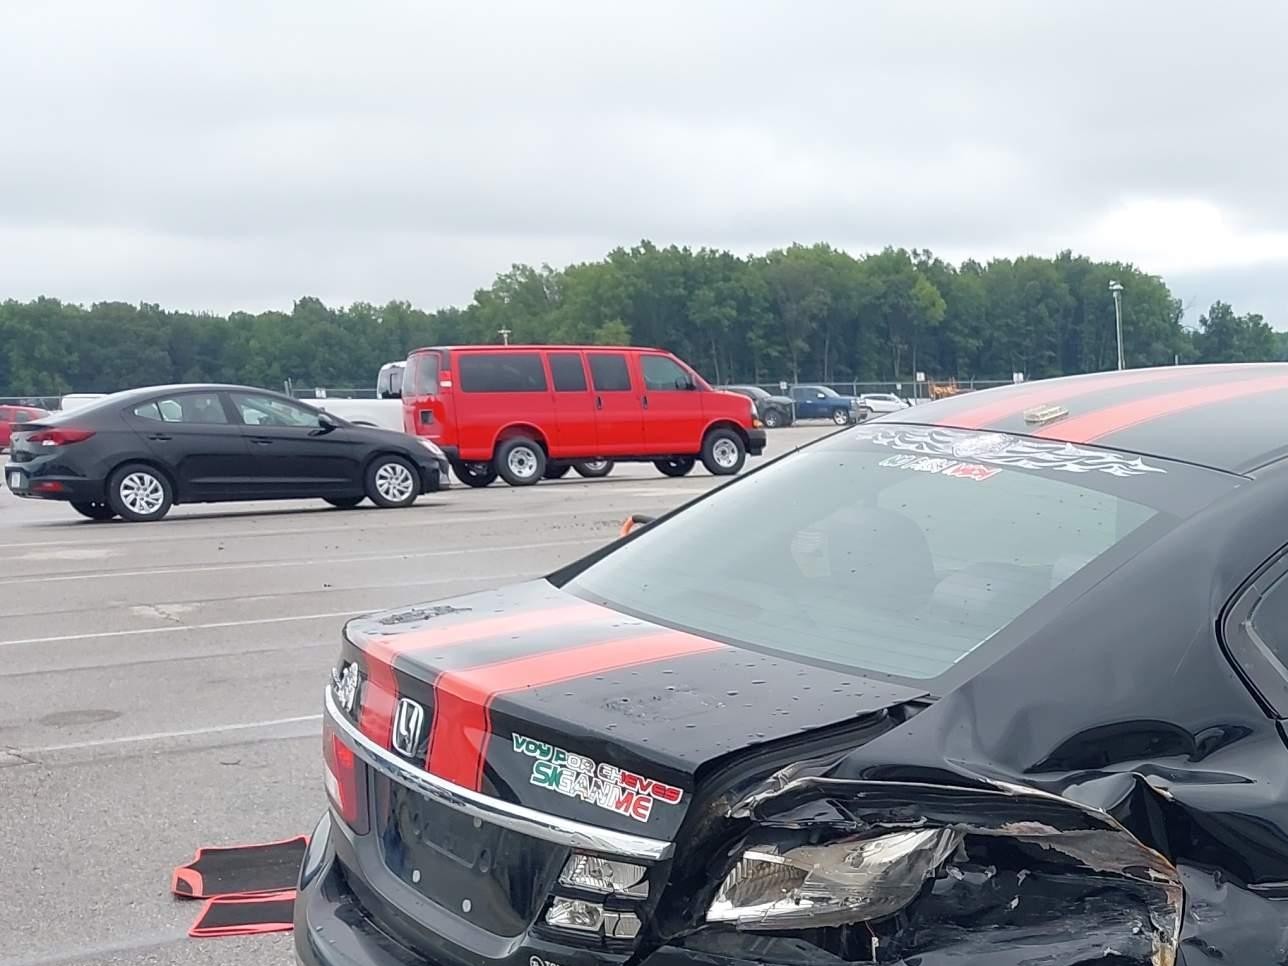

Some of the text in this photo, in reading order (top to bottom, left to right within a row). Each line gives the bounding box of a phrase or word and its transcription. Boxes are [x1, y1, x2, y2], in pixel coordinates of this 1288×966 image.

[512, 733, 552, 760] VOY
[551, 747, 596, 777] POR
[530, 759, 654, 823] SIGANME
